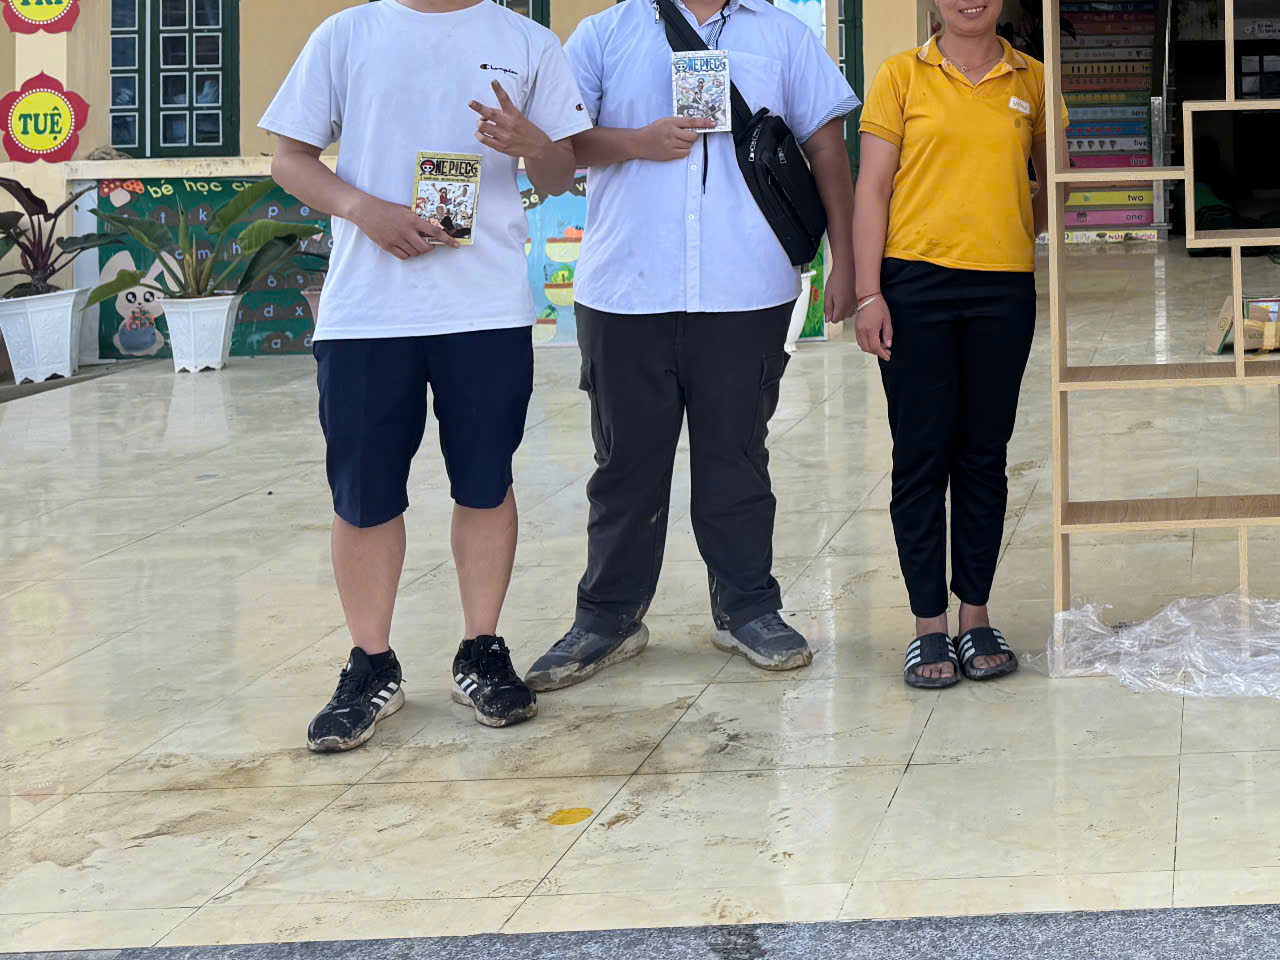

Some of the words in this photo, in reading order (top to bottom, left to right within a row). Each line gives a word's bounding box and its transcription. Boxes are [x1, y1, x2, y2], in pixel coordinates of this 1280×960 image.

[699, 57, 727, 72] PIECE
[18, 107, 63, 141] TUỆ
[448, 160, 479, 177] PIECE
[147, 180, 174, 199] bé
[183, 179, 223, 195] học
[1128, 193, 1144, 201] two
[199, 208, 208, 221] k
[268, 205, 279, 219] p
[300, 206, 310, 216] e
[1126, 213, 1143, 221] one
[197, 249, 211, 260] m
[232, 242, 241, 256] h
[263, 305, 274, 318] d
[295, 306, 304, 317] x
